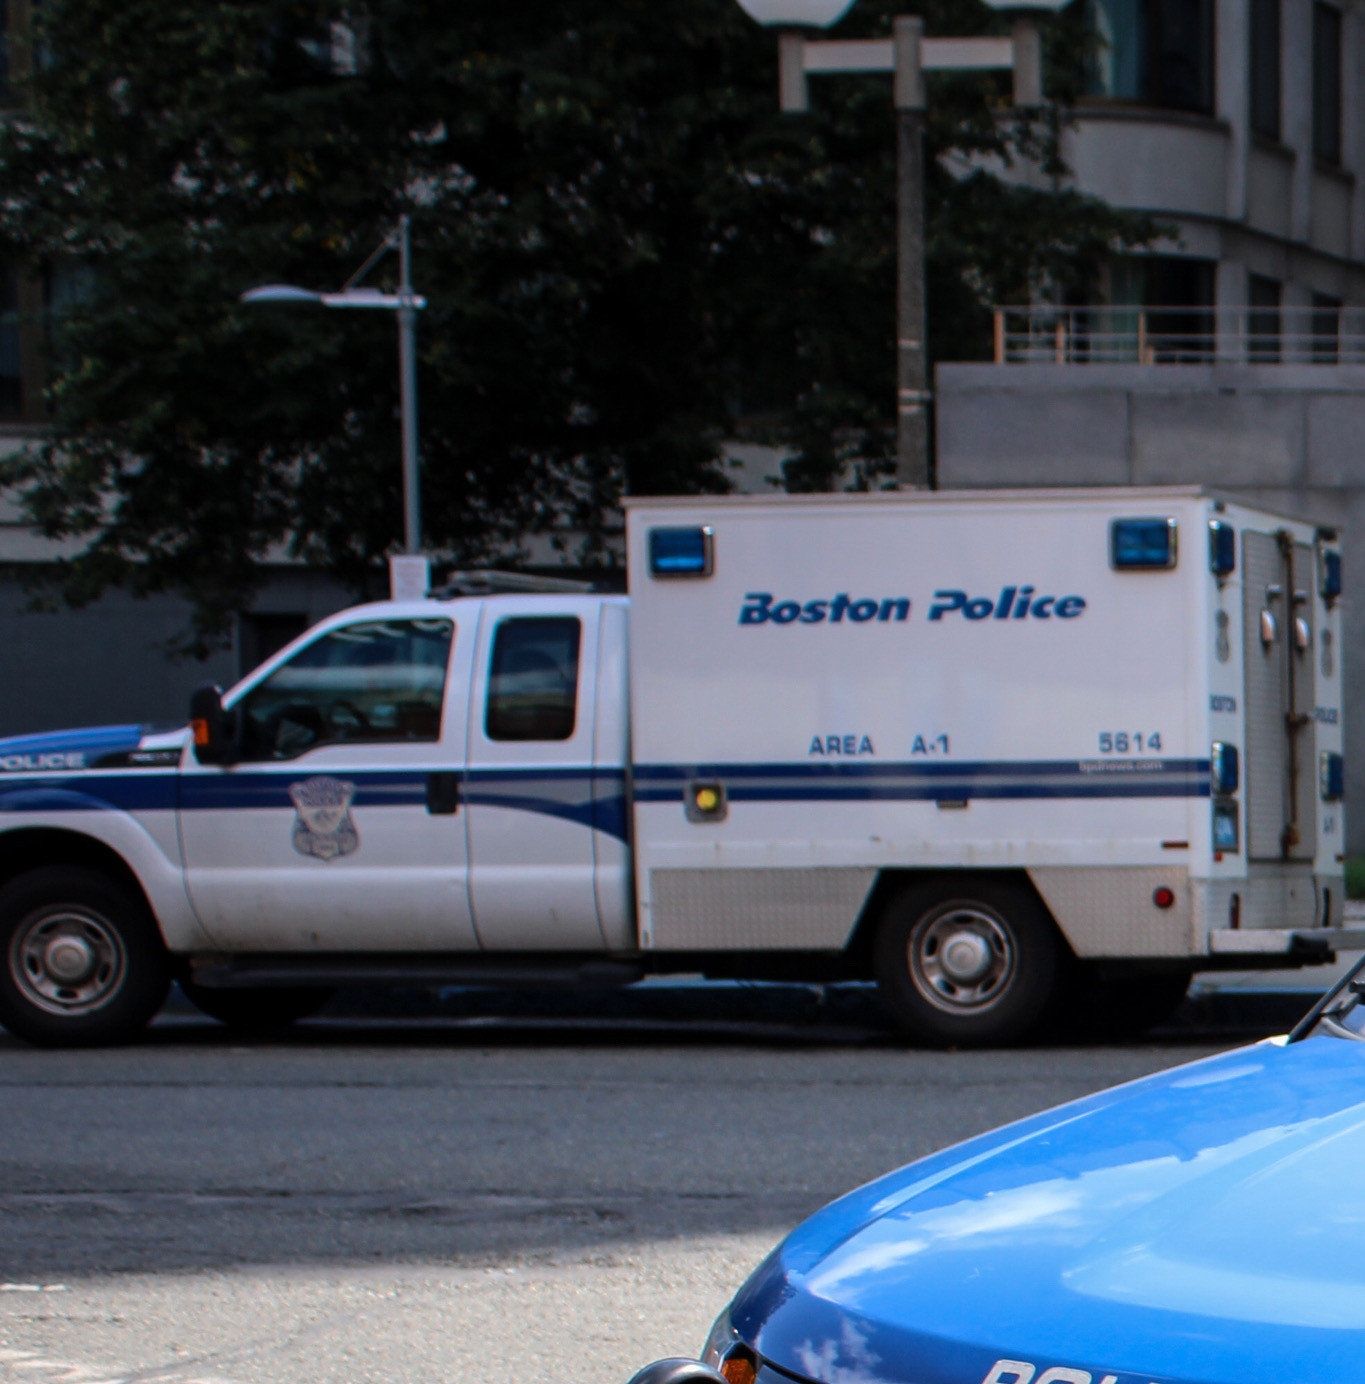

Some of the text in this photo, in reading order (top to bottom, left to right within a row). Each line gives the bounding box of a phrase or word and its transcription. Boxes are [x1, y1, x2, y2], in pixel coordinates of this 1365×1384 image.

[738, 585, 1086, 625] Boston Police
[809, 734, 950, 755] AREA A-1
[1099, 732, 1163, 753] 5614
[0, 752, 86, 770] OLICE
